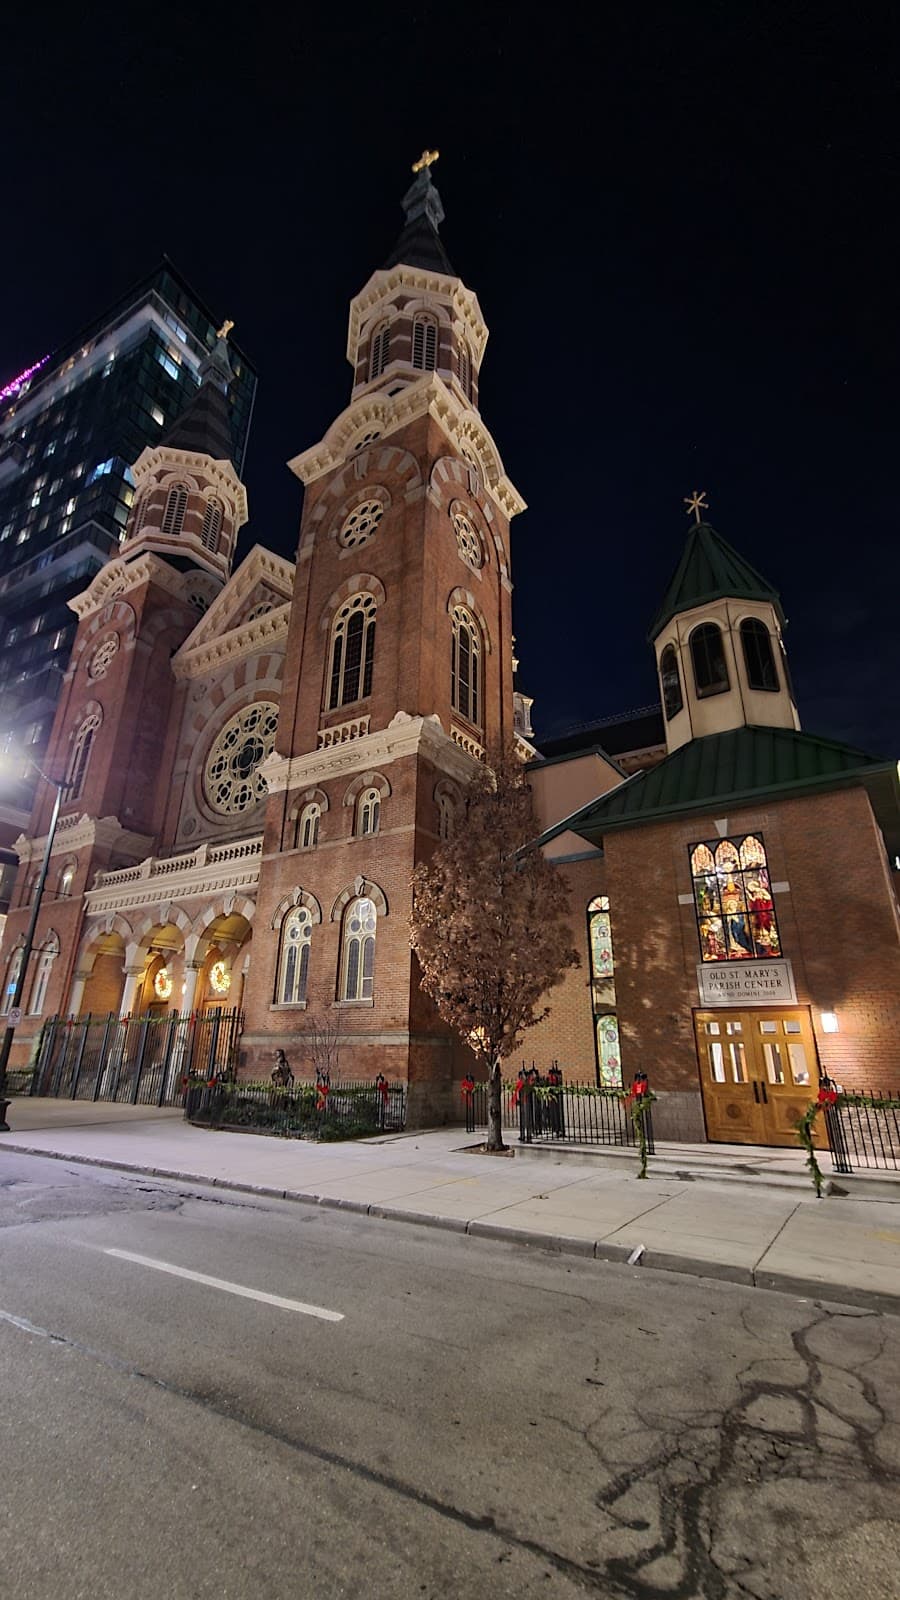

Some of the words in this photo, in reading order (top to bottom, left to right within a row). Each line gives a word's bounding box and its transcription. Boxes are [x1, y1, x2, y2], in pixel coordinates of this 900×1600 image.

[709, 971, 726, 980] OLD
[744, 969, 778, 978] MARY'S
[708, 981, 741, 990] PARISH
[744, 979, 783, 988] CENTER
